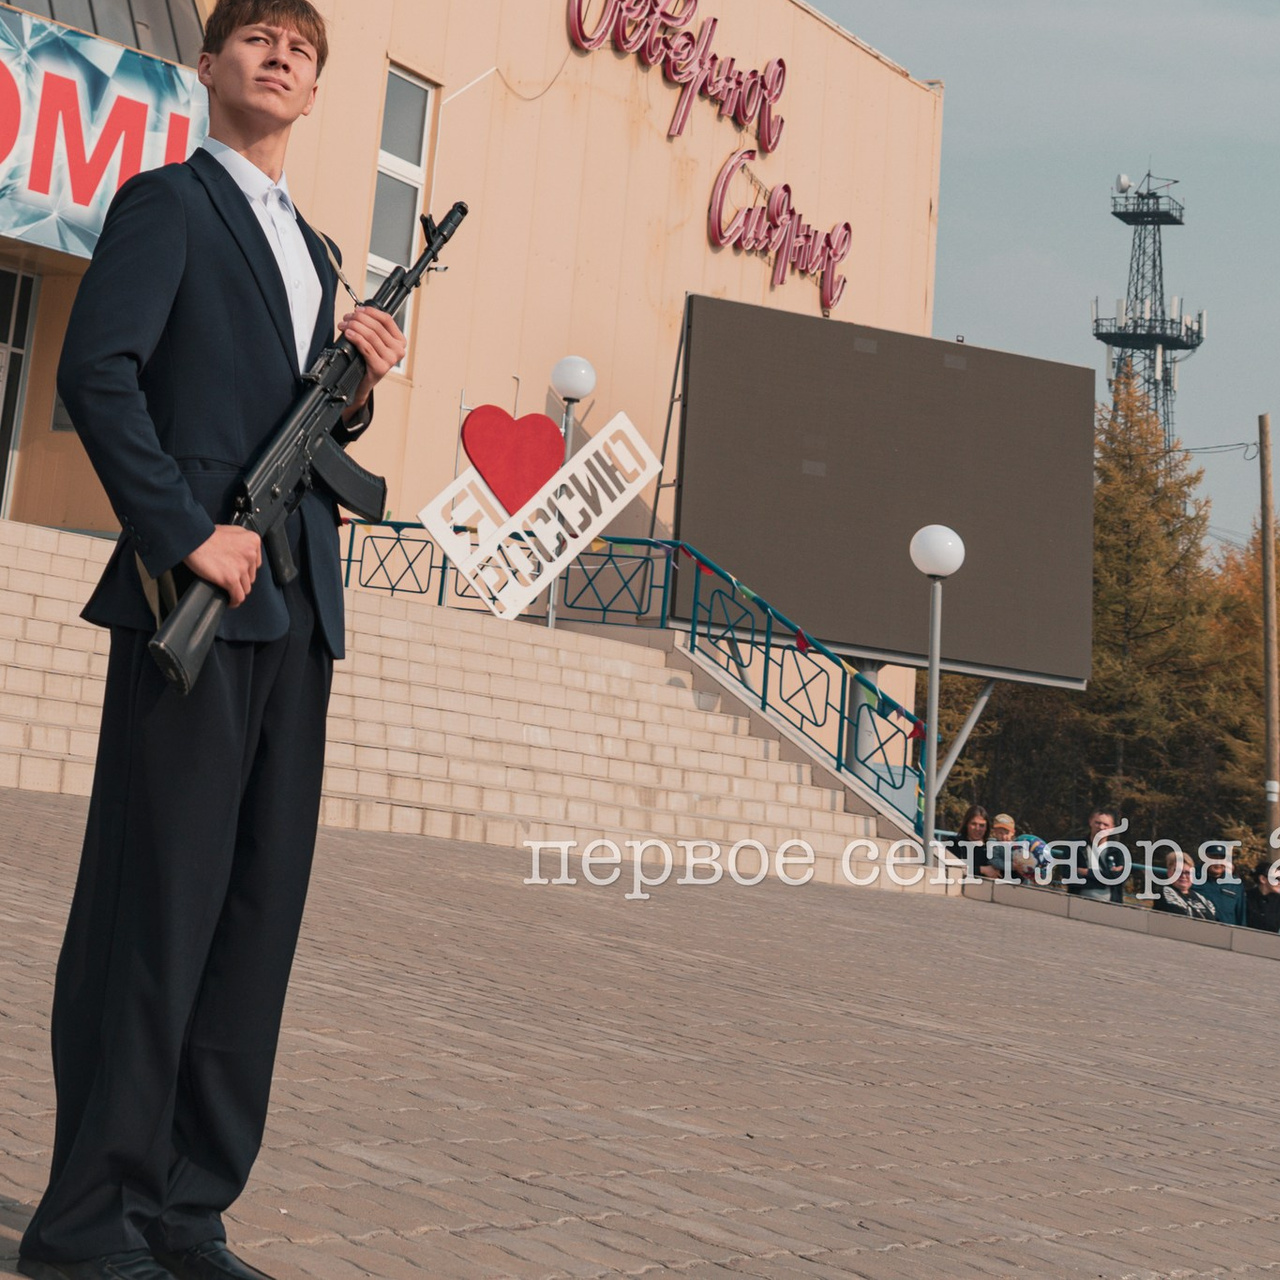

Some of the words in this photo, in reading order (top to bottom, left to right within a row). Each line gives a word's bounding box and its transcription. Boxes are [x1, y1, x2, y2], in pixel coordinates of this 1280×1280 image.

[708, 149, 852, 309] Сияние
[440, 479, 507, 537] Я
[469, 428, 648, 614] РОССИЮ
